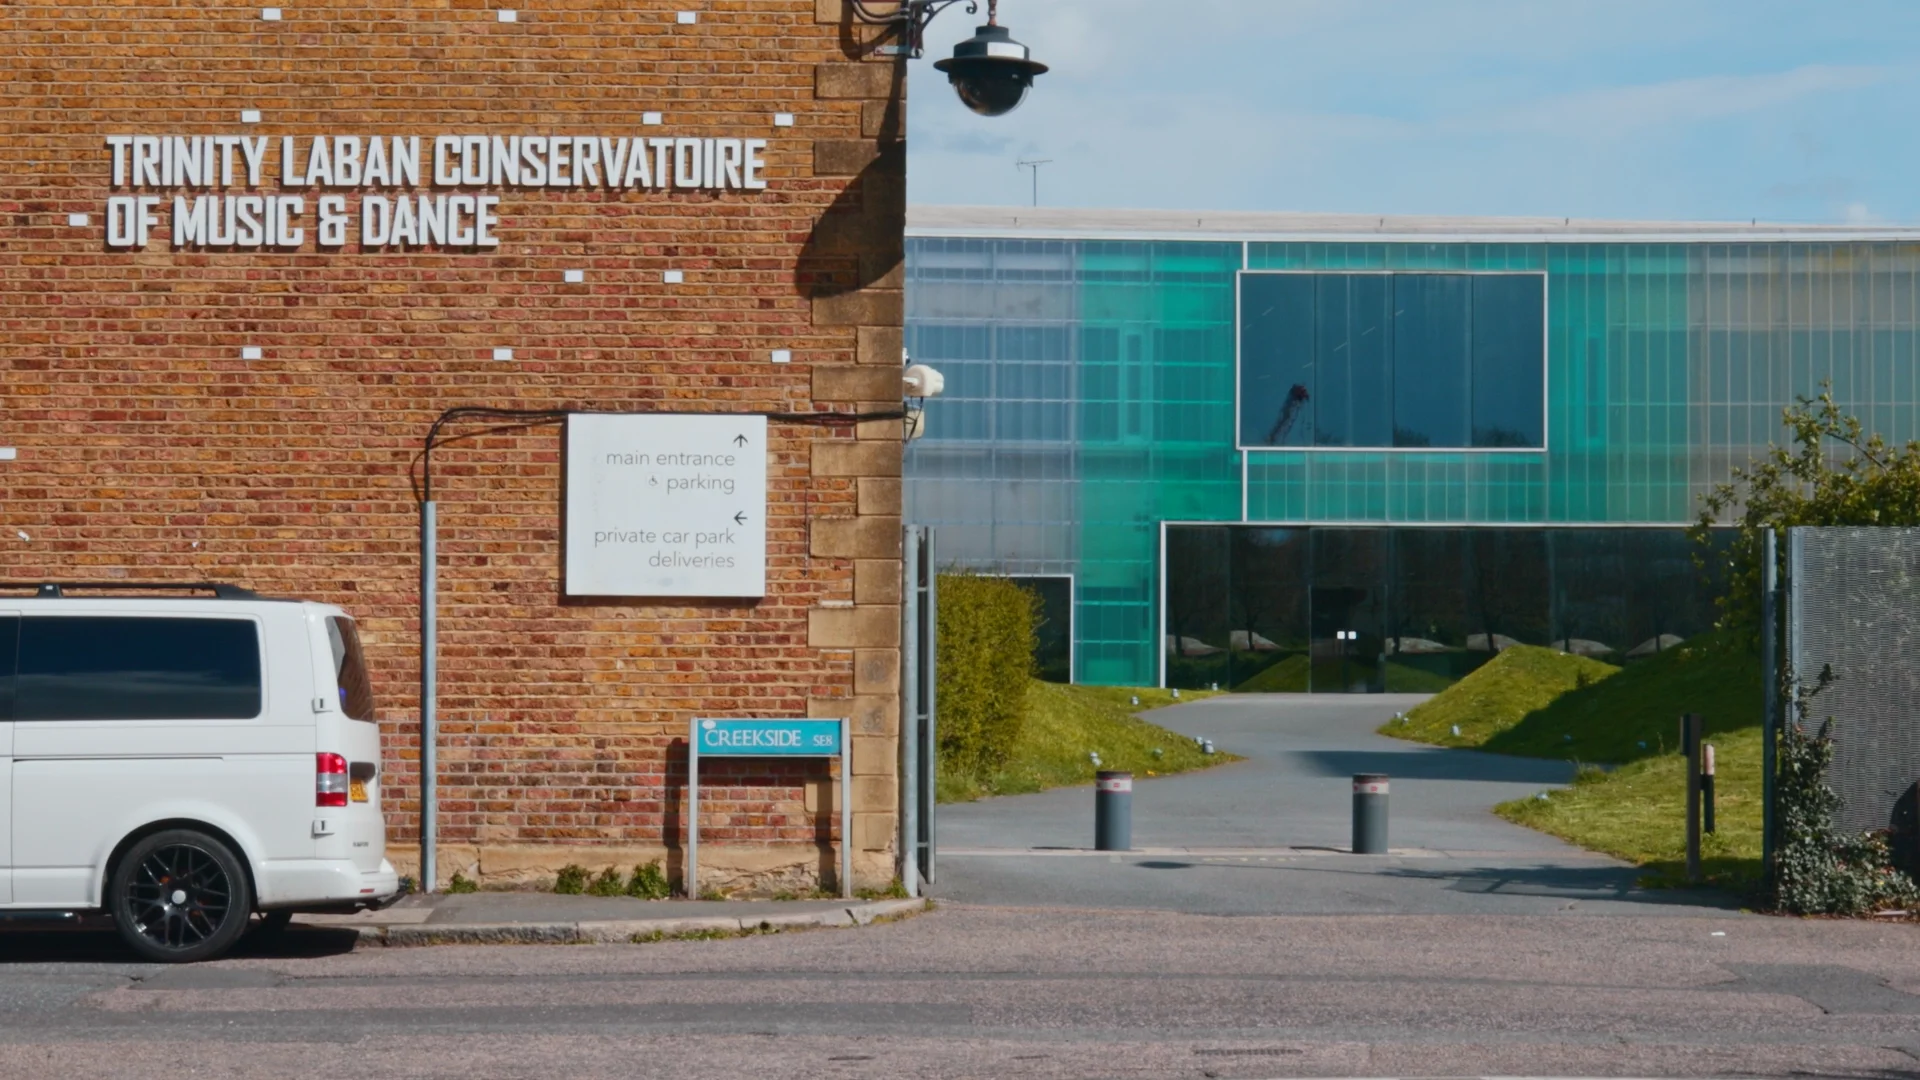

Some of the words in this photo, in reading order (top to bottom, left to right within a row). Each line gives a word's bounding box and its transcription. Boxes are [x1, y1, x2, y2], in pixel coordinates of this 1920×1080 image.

[107, 135, 267, 186] TRINITY
[282, 135, 419, 186] LABAN
[434, 136, 766, 190] CONSERVATOIRE
[107, 195, 159, 247] OF
[174, 195, 304, 247] MUSIC
[319, 195, 347, 247] &
[363, 196, 500, 247] DANCE
[606, 450, 650, 465] main
[656, 452, 735, 466] entrance
[667, 473, 735, 495] parking
[594, 526, 656, 548] private
[662, 531, 690, 543] car
[695, 528, 735, 549] park
[648, 550, 735, 568] deliveries
[705, 730, 801, 746] CREEKSIDE
[813, 735, 833, 747] SE8
